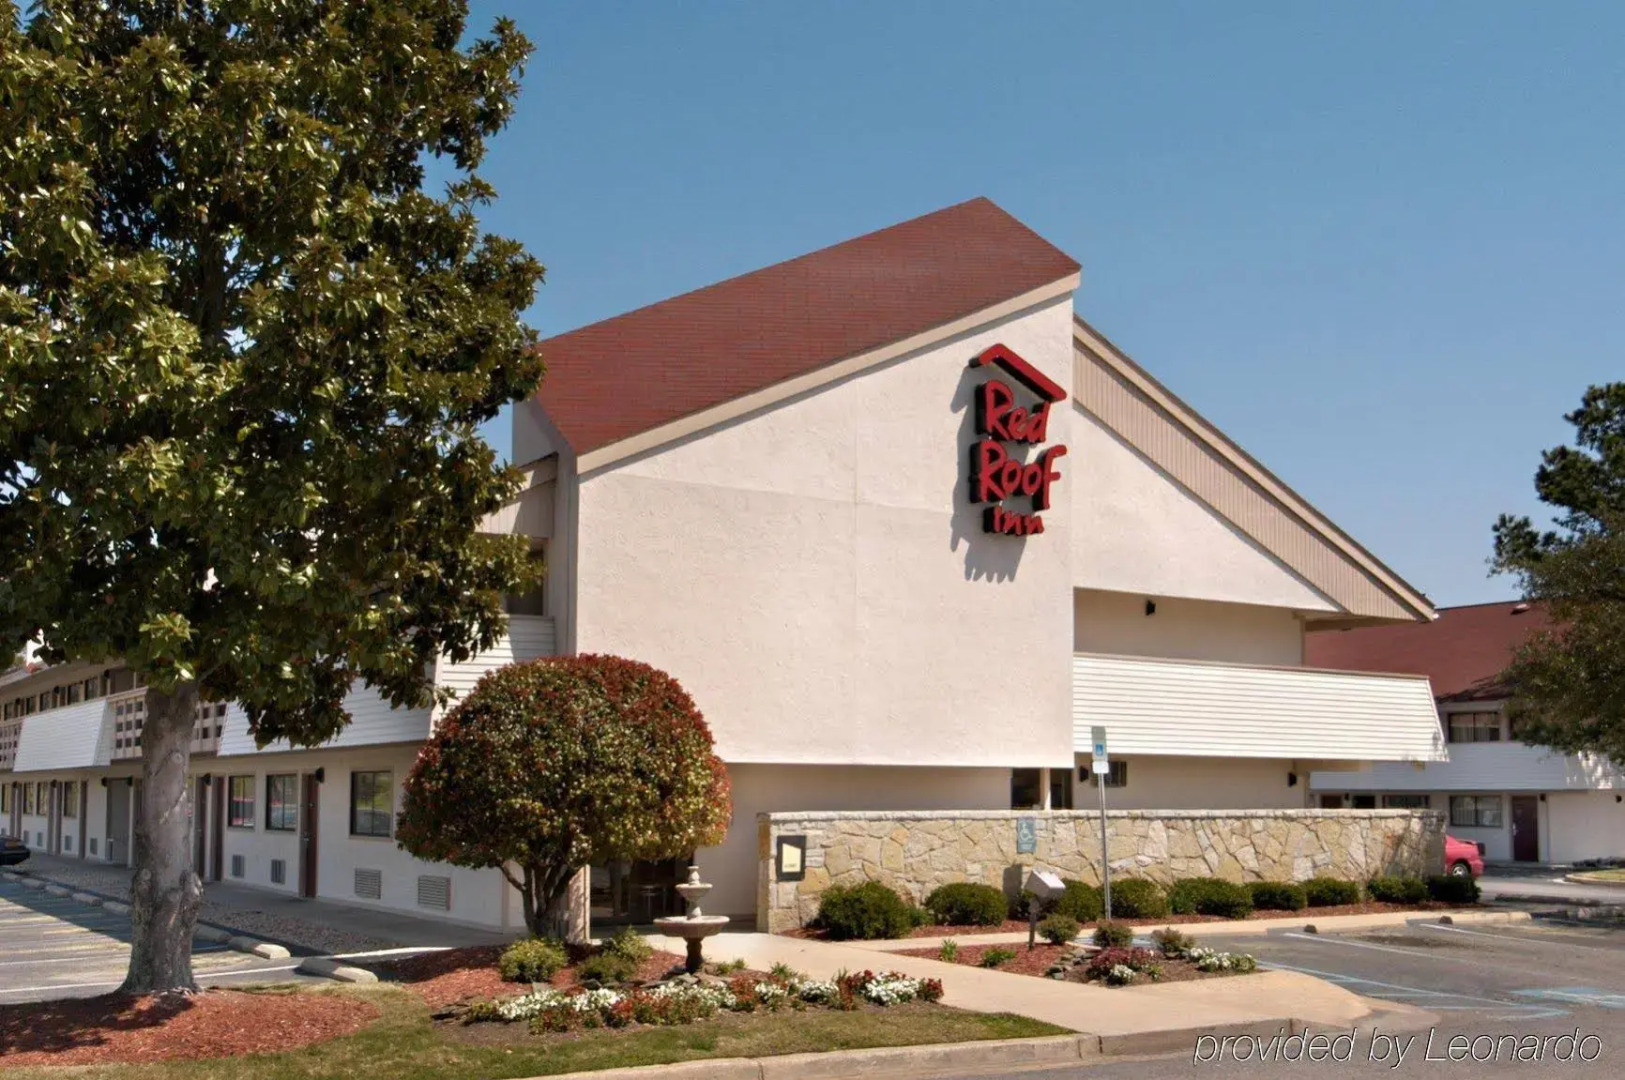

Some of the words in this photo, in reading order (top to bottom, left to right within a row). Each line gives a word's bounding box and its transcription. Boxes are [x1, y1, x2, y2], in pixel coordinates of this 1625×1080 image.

[983, 378, 1051, 443] Red
[978, 438, 1067, 510] Roof
[990, 505, 1044, 535] Inn
